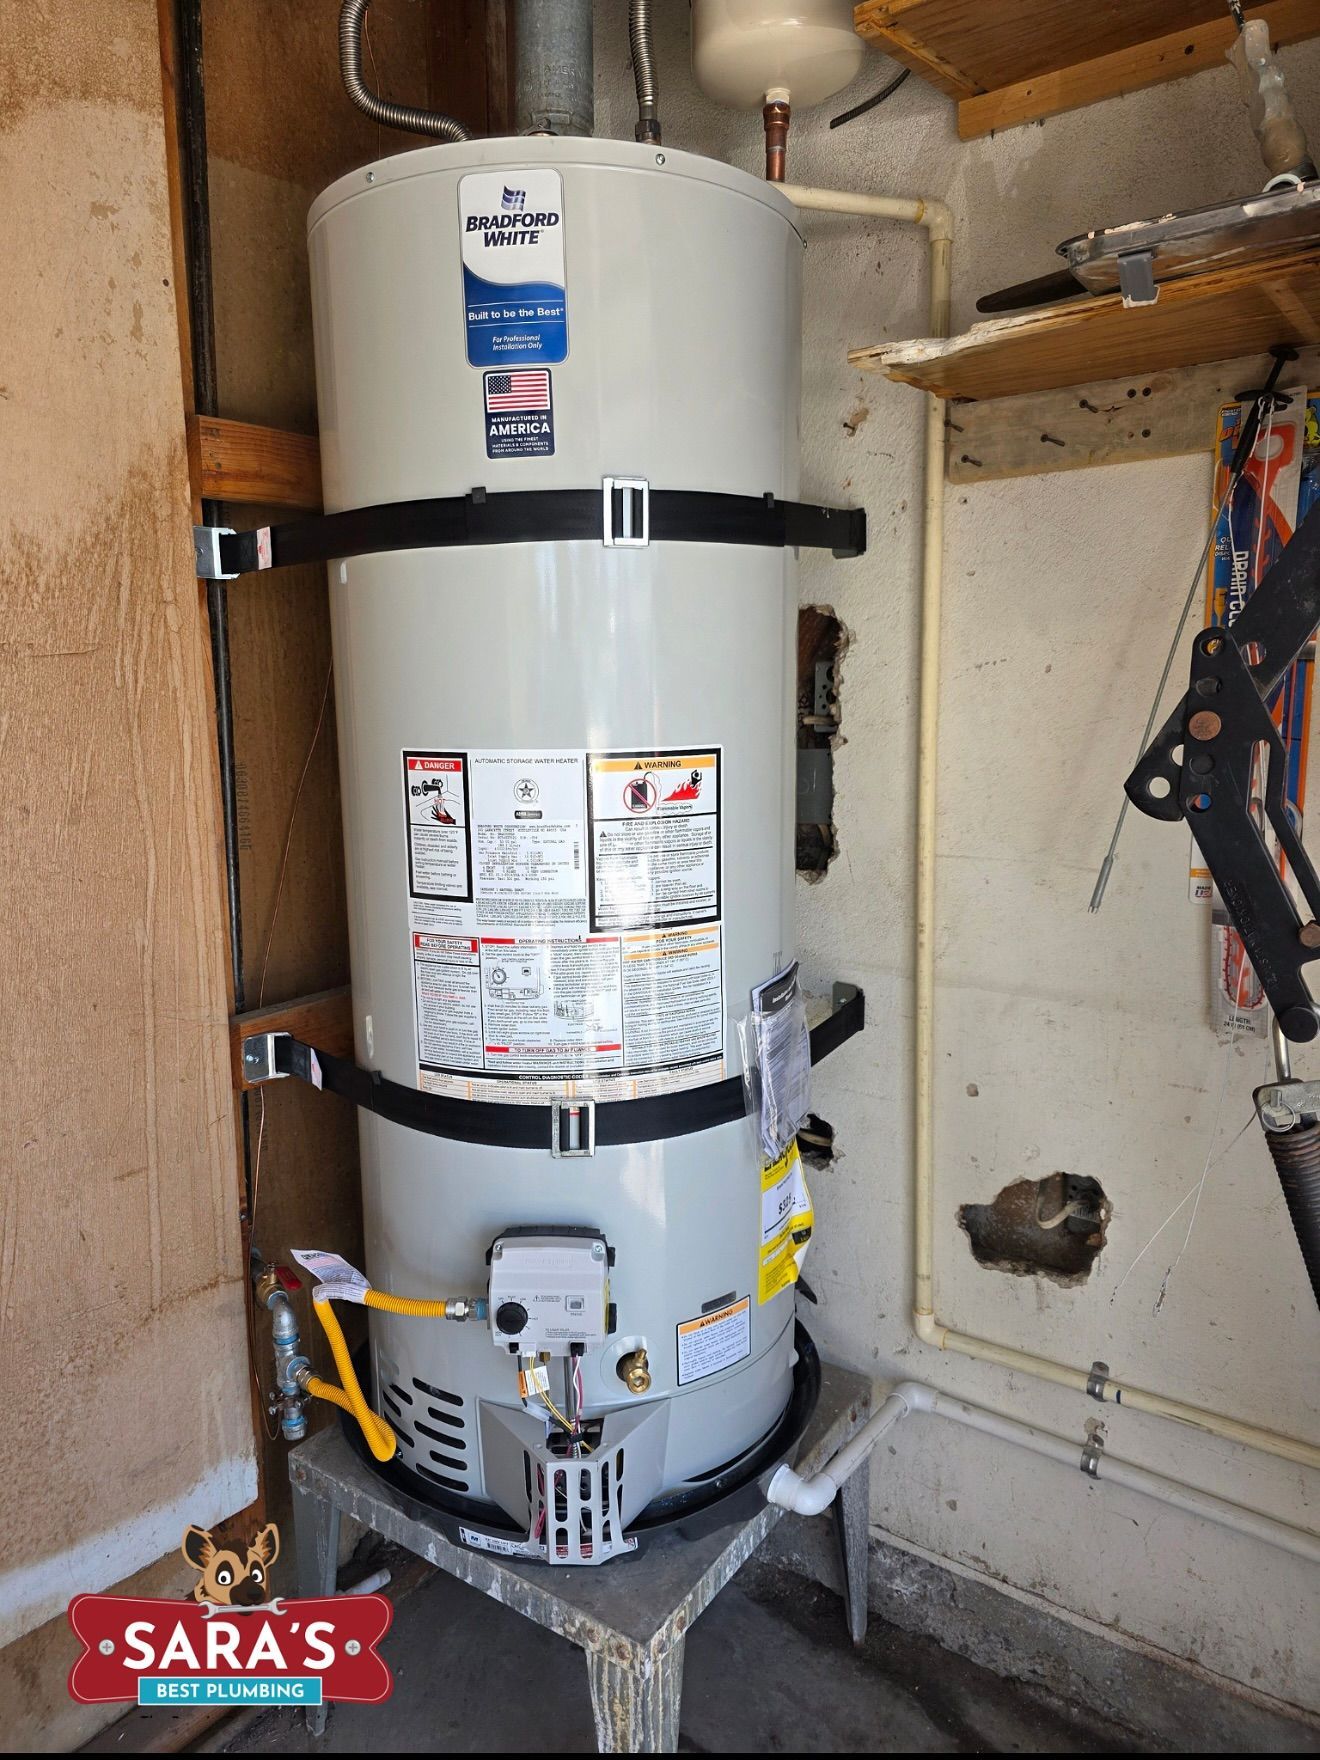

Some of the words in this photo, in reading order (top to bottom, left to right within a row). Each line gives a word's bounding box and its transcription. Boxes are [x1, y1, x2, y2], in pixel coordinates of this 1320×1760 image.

[466, 212, 559, 232] BRADFORD
[484, 230, 540, 248] WHITE
[468, 312, 489, 321] Built
[490, 310, 500, 319] to
[504, 309, 516, 318] be
[518, 308, 534, 317] the
[504, 334, 540, 342] Professional
[492, 343, 527, 351] Installation
[528, 342, 542, 350] Only
[490, 422, 550, 436] AMERICA
[1230, 550, 1249, 596] DRAIN
[424, 762, 454, 770] DANGER
[644, 760, 682, 768] WARNING
[704, 1308, 733, 1325] WARNING
